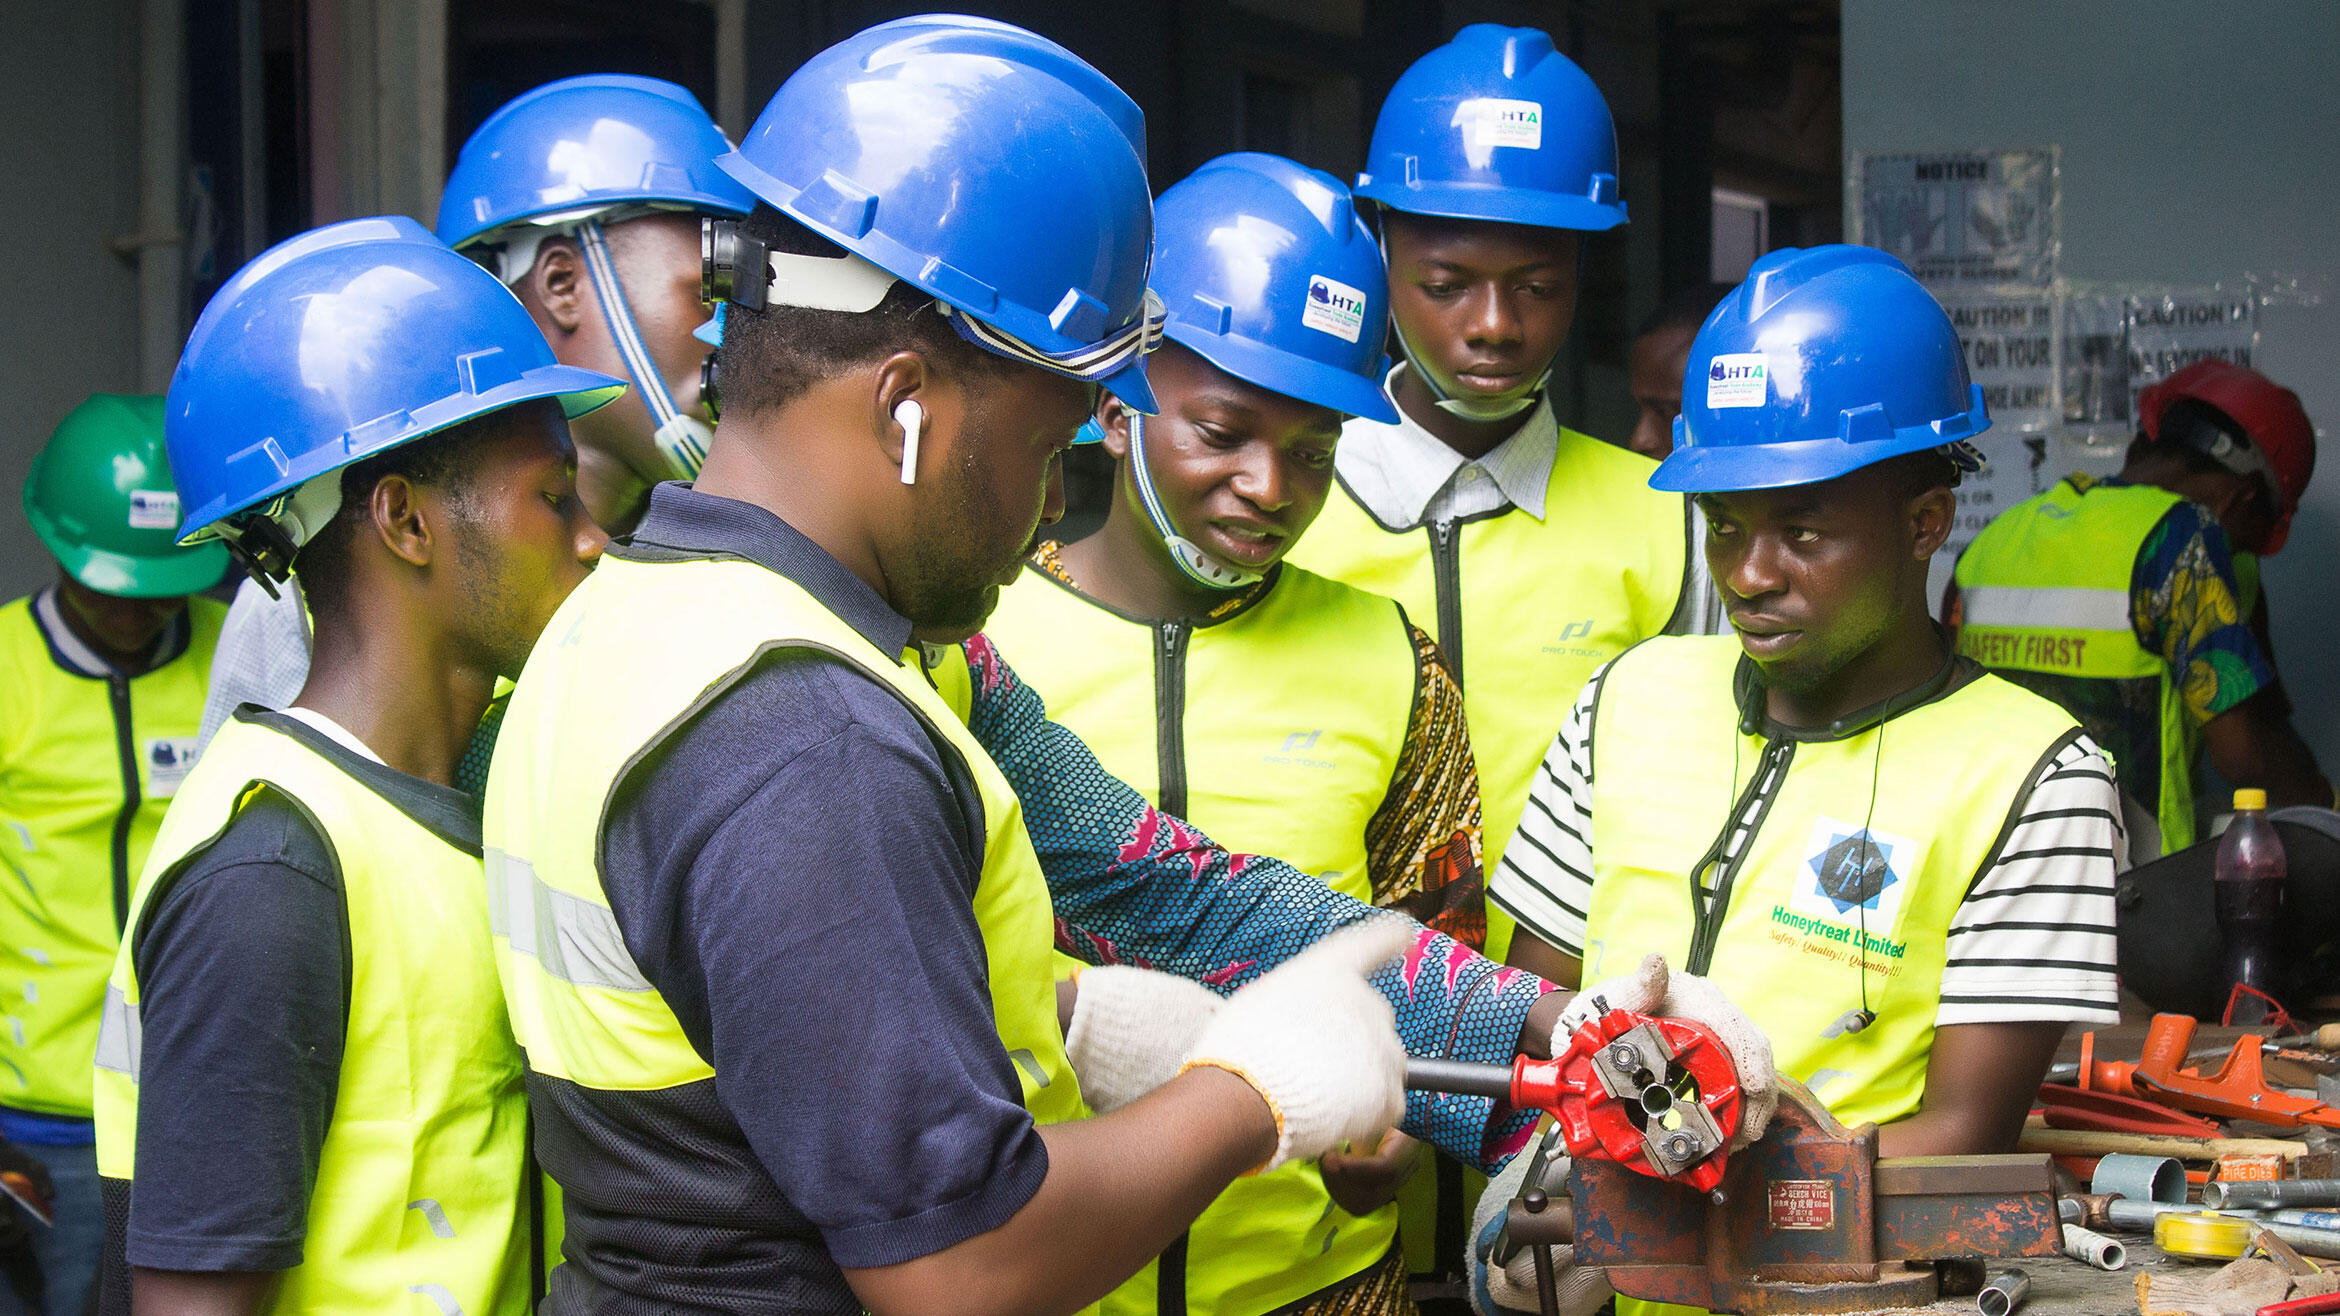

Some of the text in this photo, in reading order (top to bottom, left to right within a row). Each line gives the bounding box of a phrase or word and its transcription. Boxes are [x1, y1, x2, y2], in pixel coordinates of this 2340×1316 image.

[1502, 111, 1538, 124] HTA
[1916, 161, 1988, 180] NOTICE
[1331, 293, 1362, 316] HTA
[2134, 304, 2224, 326] CAUTION
[1945, 306, 2026, 327] AUTION
[1975, 338, 1999, 368] ON
[2006, 337, 2051, 369] YOUR
[1727, 364, 1764, 379] HTA
[1541, 646, 1603, 657] PRO TOUCH
[2025, 635, 2086, 669] FIRST
[1771, 904, 1907, 959] Honeytreat Limited
[1788, 1189, 1827, 1199] BENCH VICE
